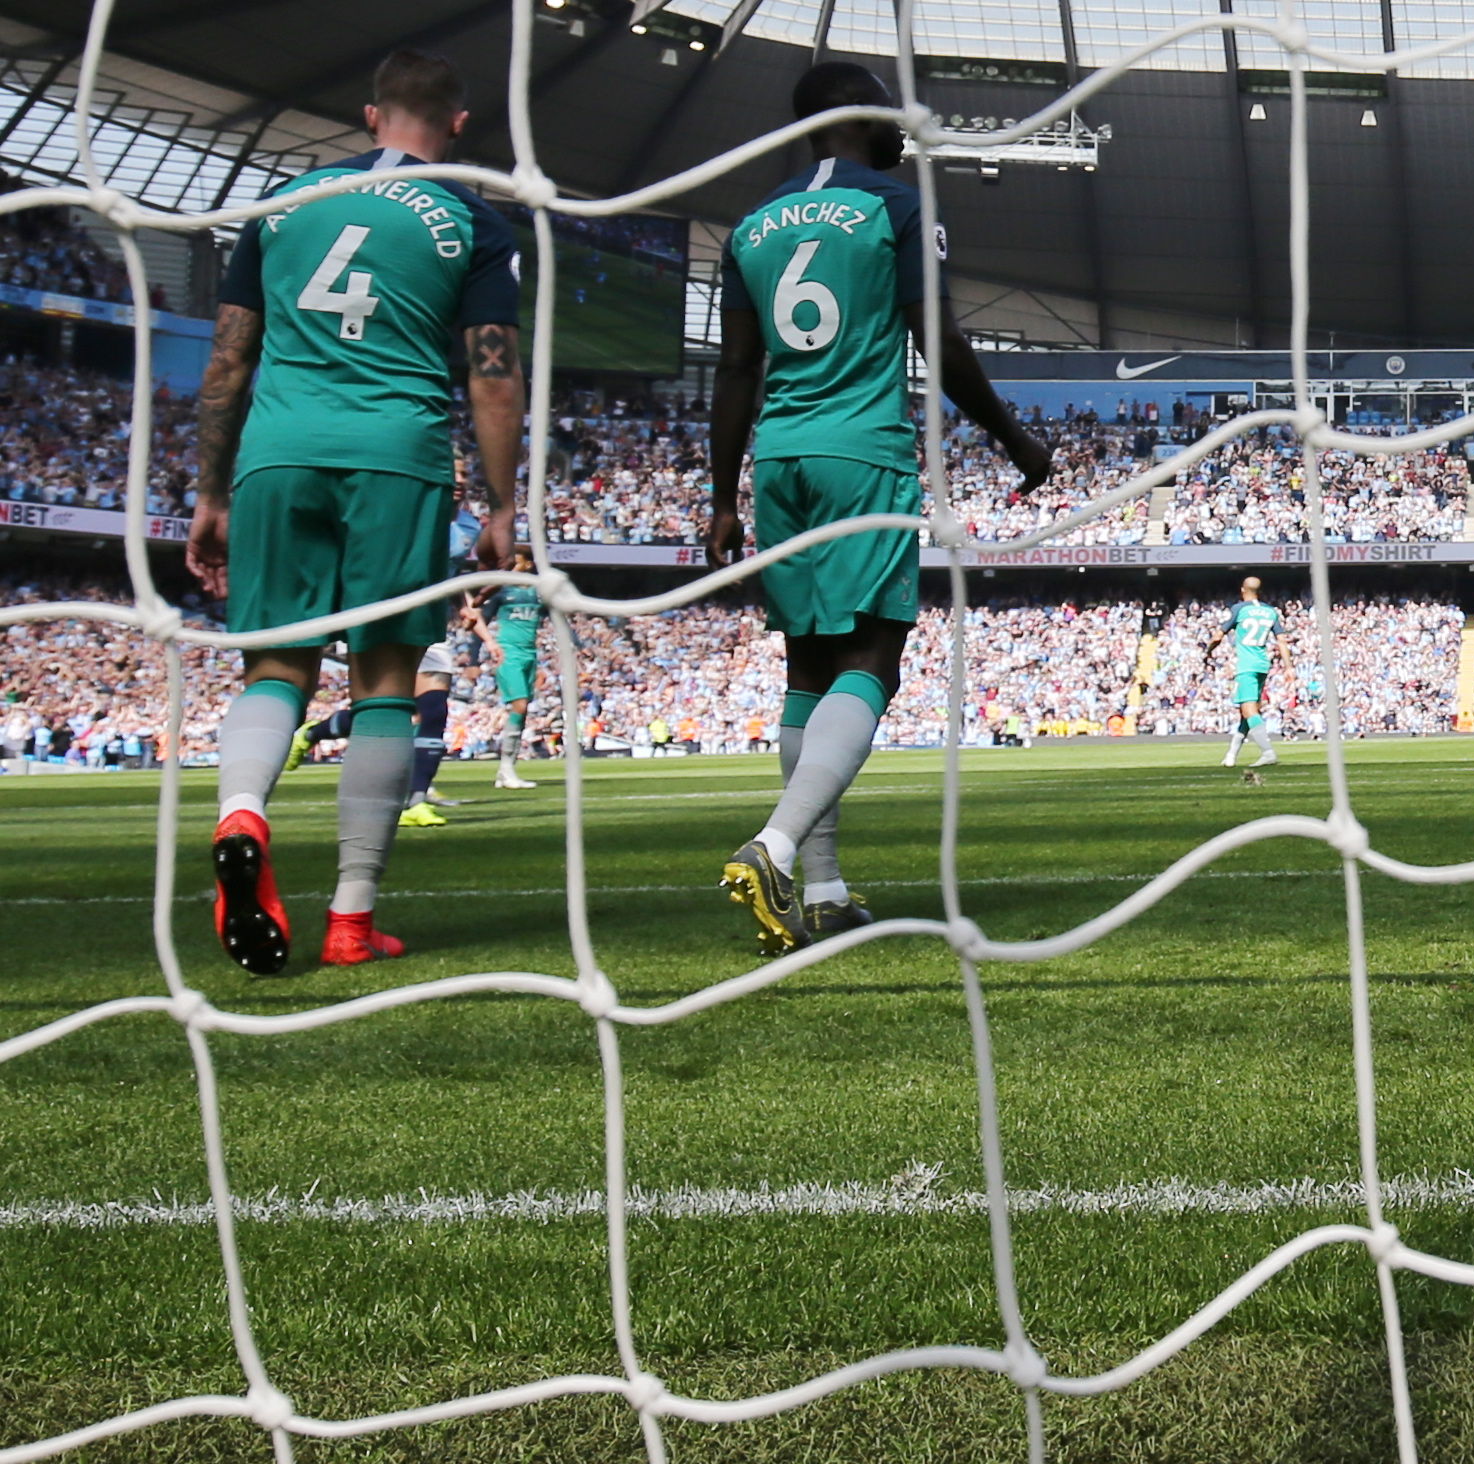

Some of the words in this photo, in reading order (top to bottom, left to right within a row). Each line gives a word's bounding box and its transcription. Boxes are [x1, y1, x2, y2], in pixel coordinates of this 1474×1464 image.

[296, 224, 380, 341] 4
[772, 239, 841, 352] 6
[977, 548, 1152, 564] MARATHONBET
[1241, 618, 1274, 647] 27
